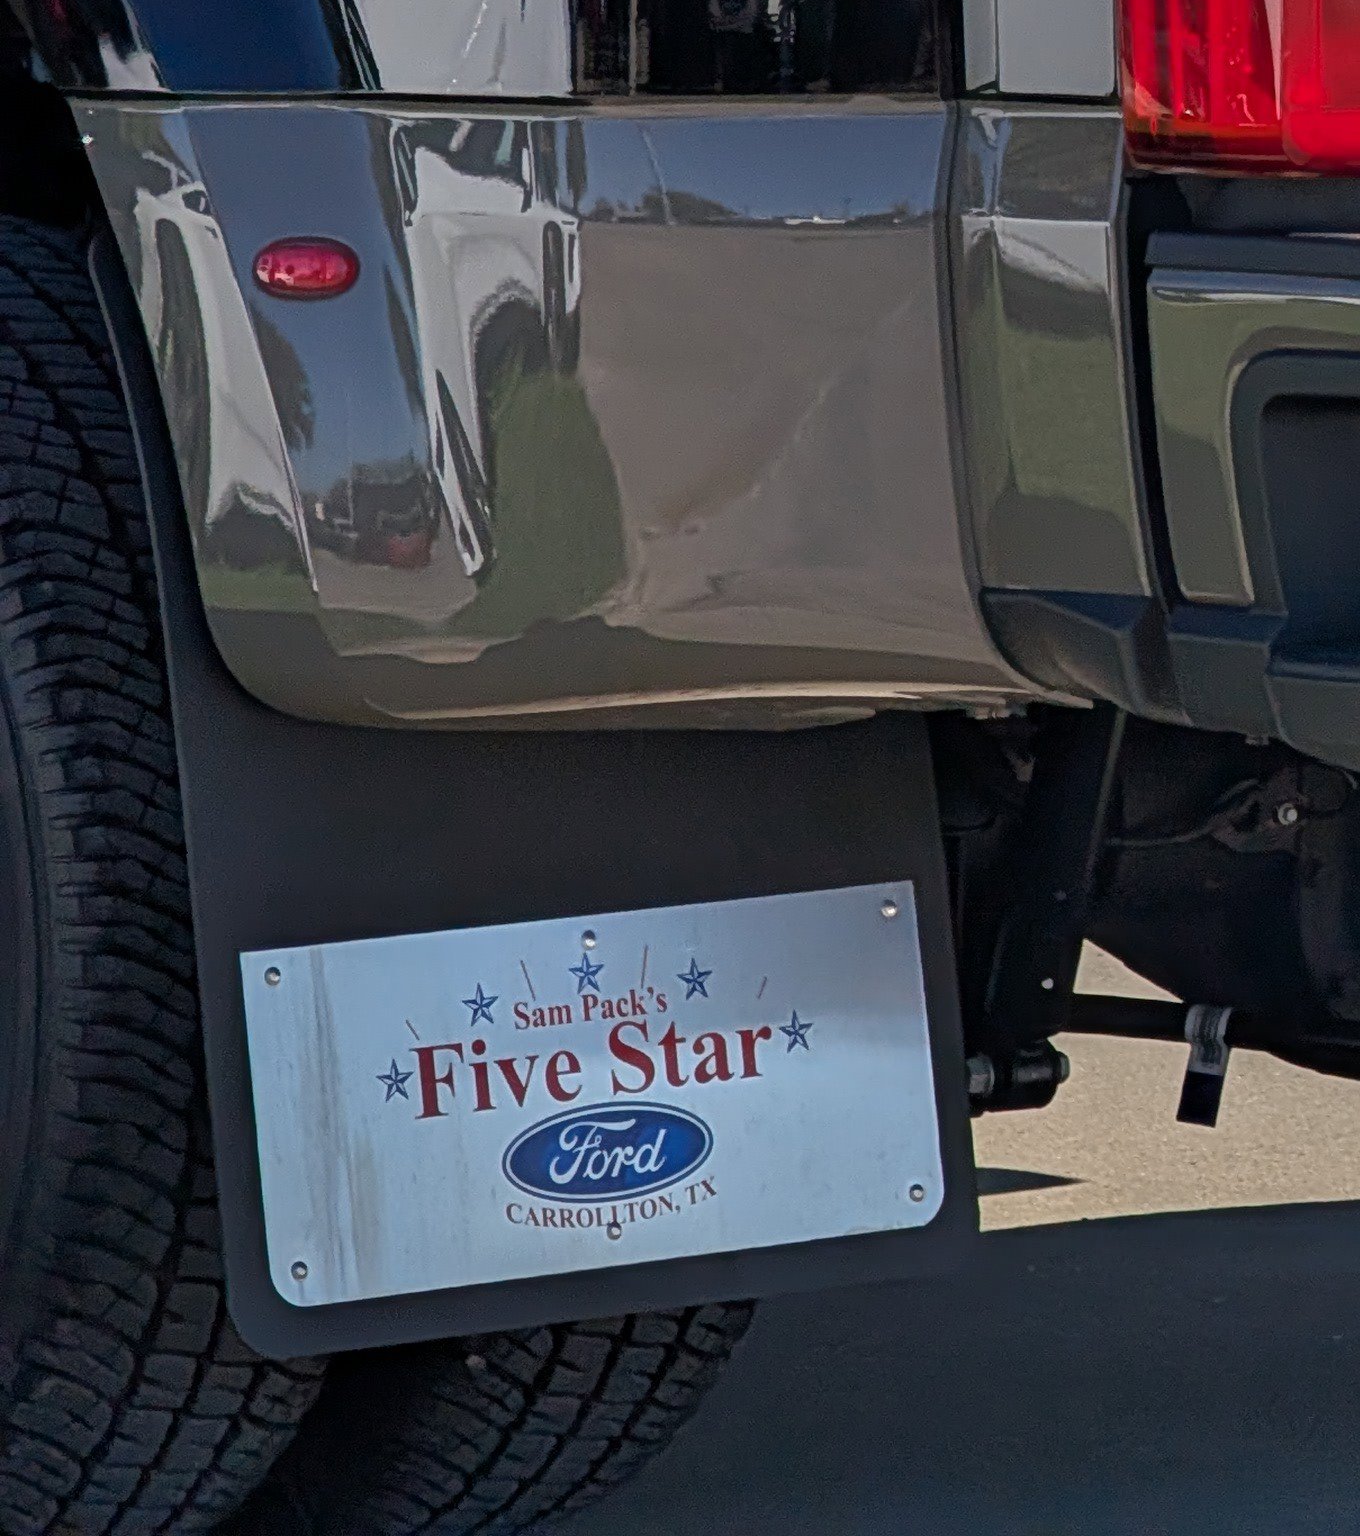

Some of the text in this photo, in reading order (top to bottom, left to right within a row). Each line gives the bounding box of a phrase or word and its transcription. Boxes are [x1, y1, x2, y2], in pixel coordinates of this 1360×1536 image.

[512, 985, 669, 1031] Sam Pack's
[411, 1019, 775, 1119] Five Star
[548, 1118, 669, 1185] Ford
[505, 1175, 719, 1230] CARROLLTON, TX
